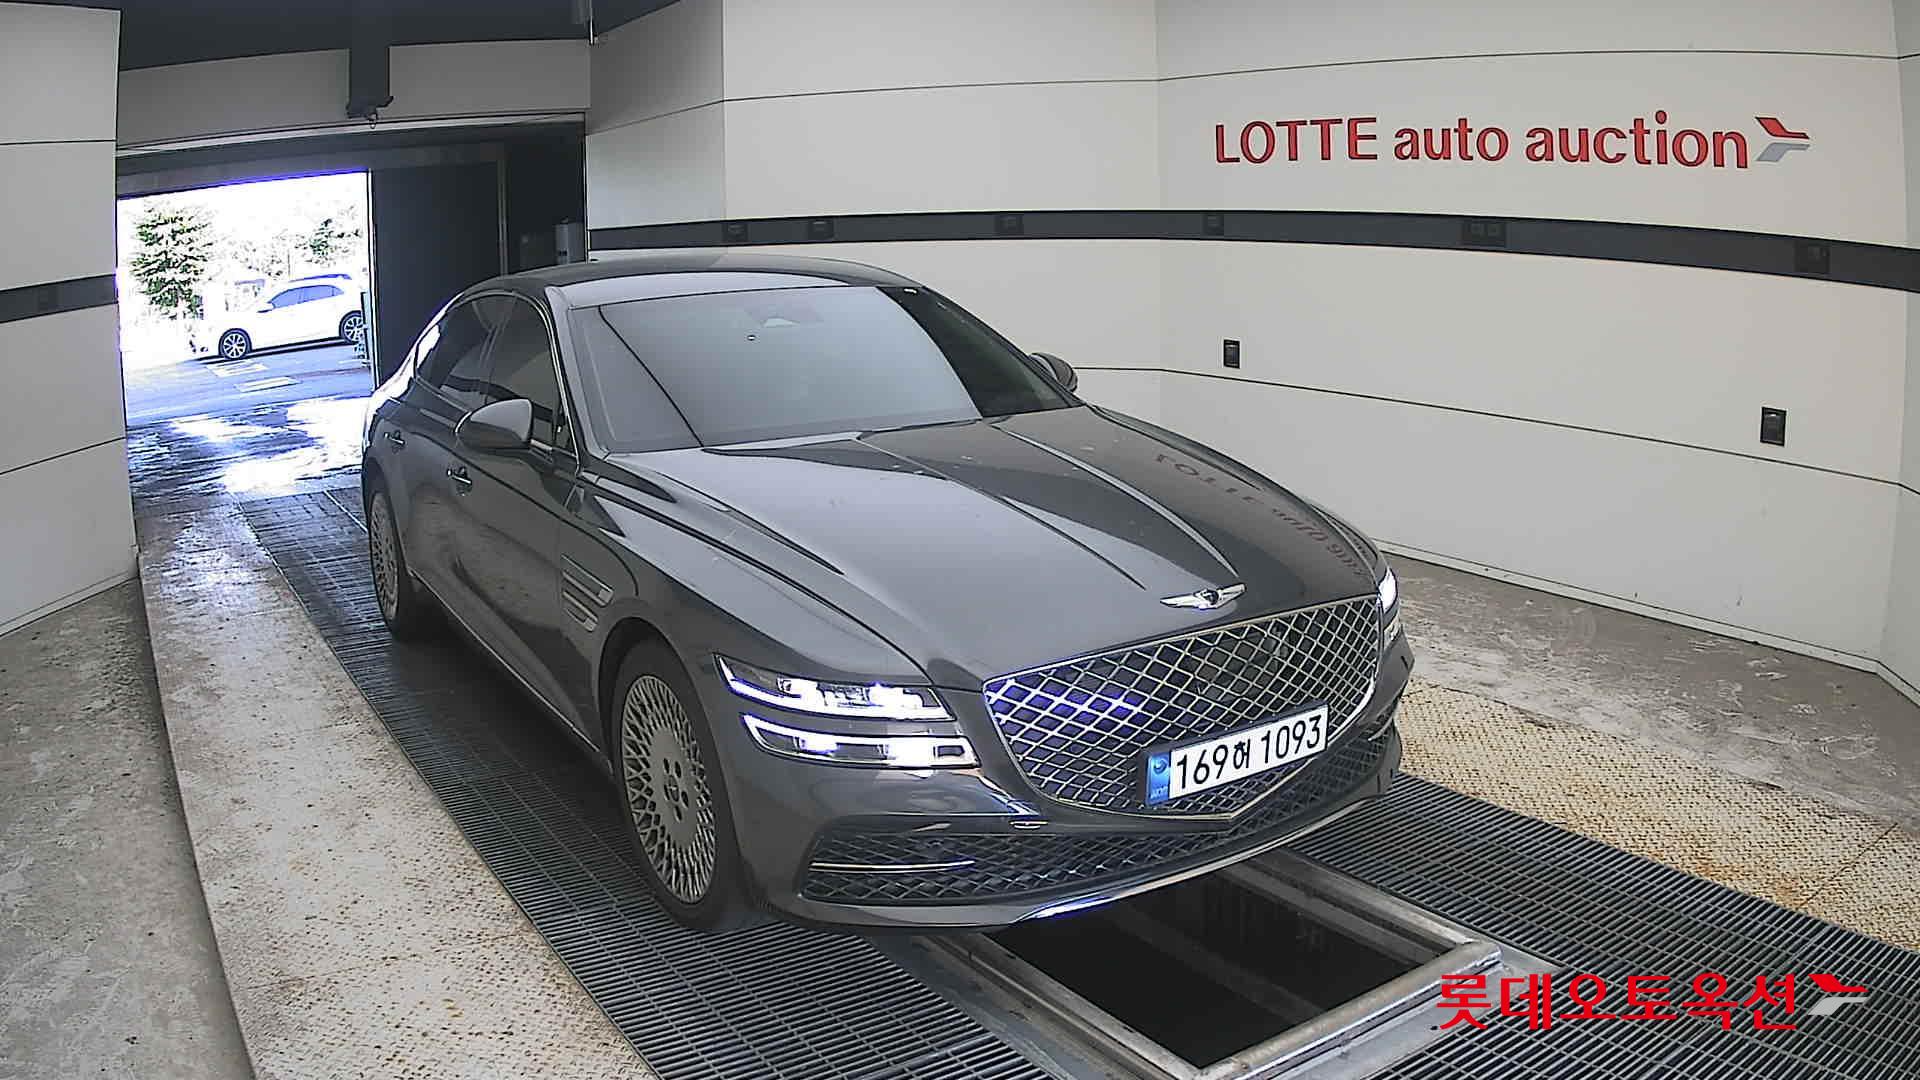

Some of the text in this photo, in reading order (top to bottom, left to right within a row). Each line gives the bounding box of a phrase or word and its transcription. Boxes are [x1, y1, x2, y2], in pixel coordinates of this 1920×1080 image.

[1215, 110, 1750, 169] LOTTE auto auction
[1177, 714, 1322, 790] 169허 1093
